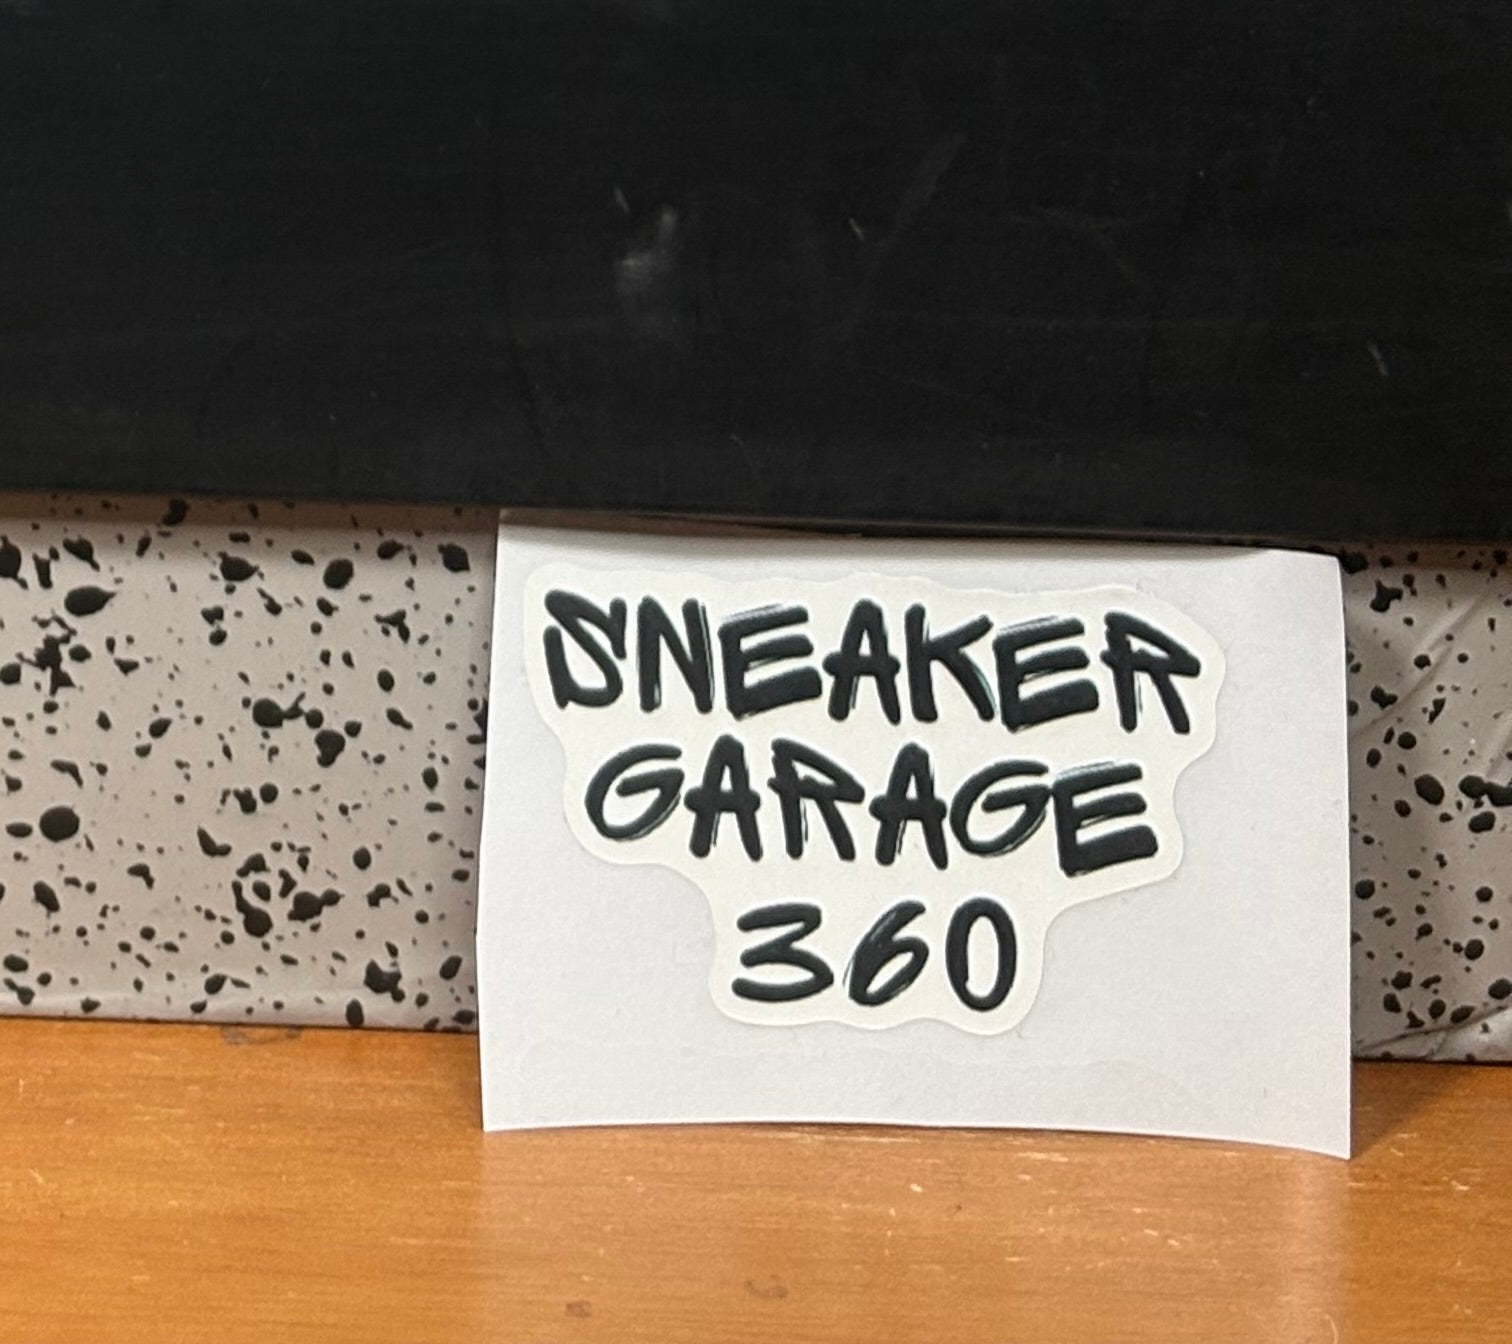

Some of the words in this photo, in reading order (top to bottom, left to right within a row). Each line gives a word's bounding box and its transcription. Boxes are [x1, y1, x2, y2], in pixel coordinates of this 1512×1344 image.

[544, 589, 1201, 736] SNEAKER
[585, 734, 1159, 878] GARAGE
[731, 898, 1017, 1013] 360
